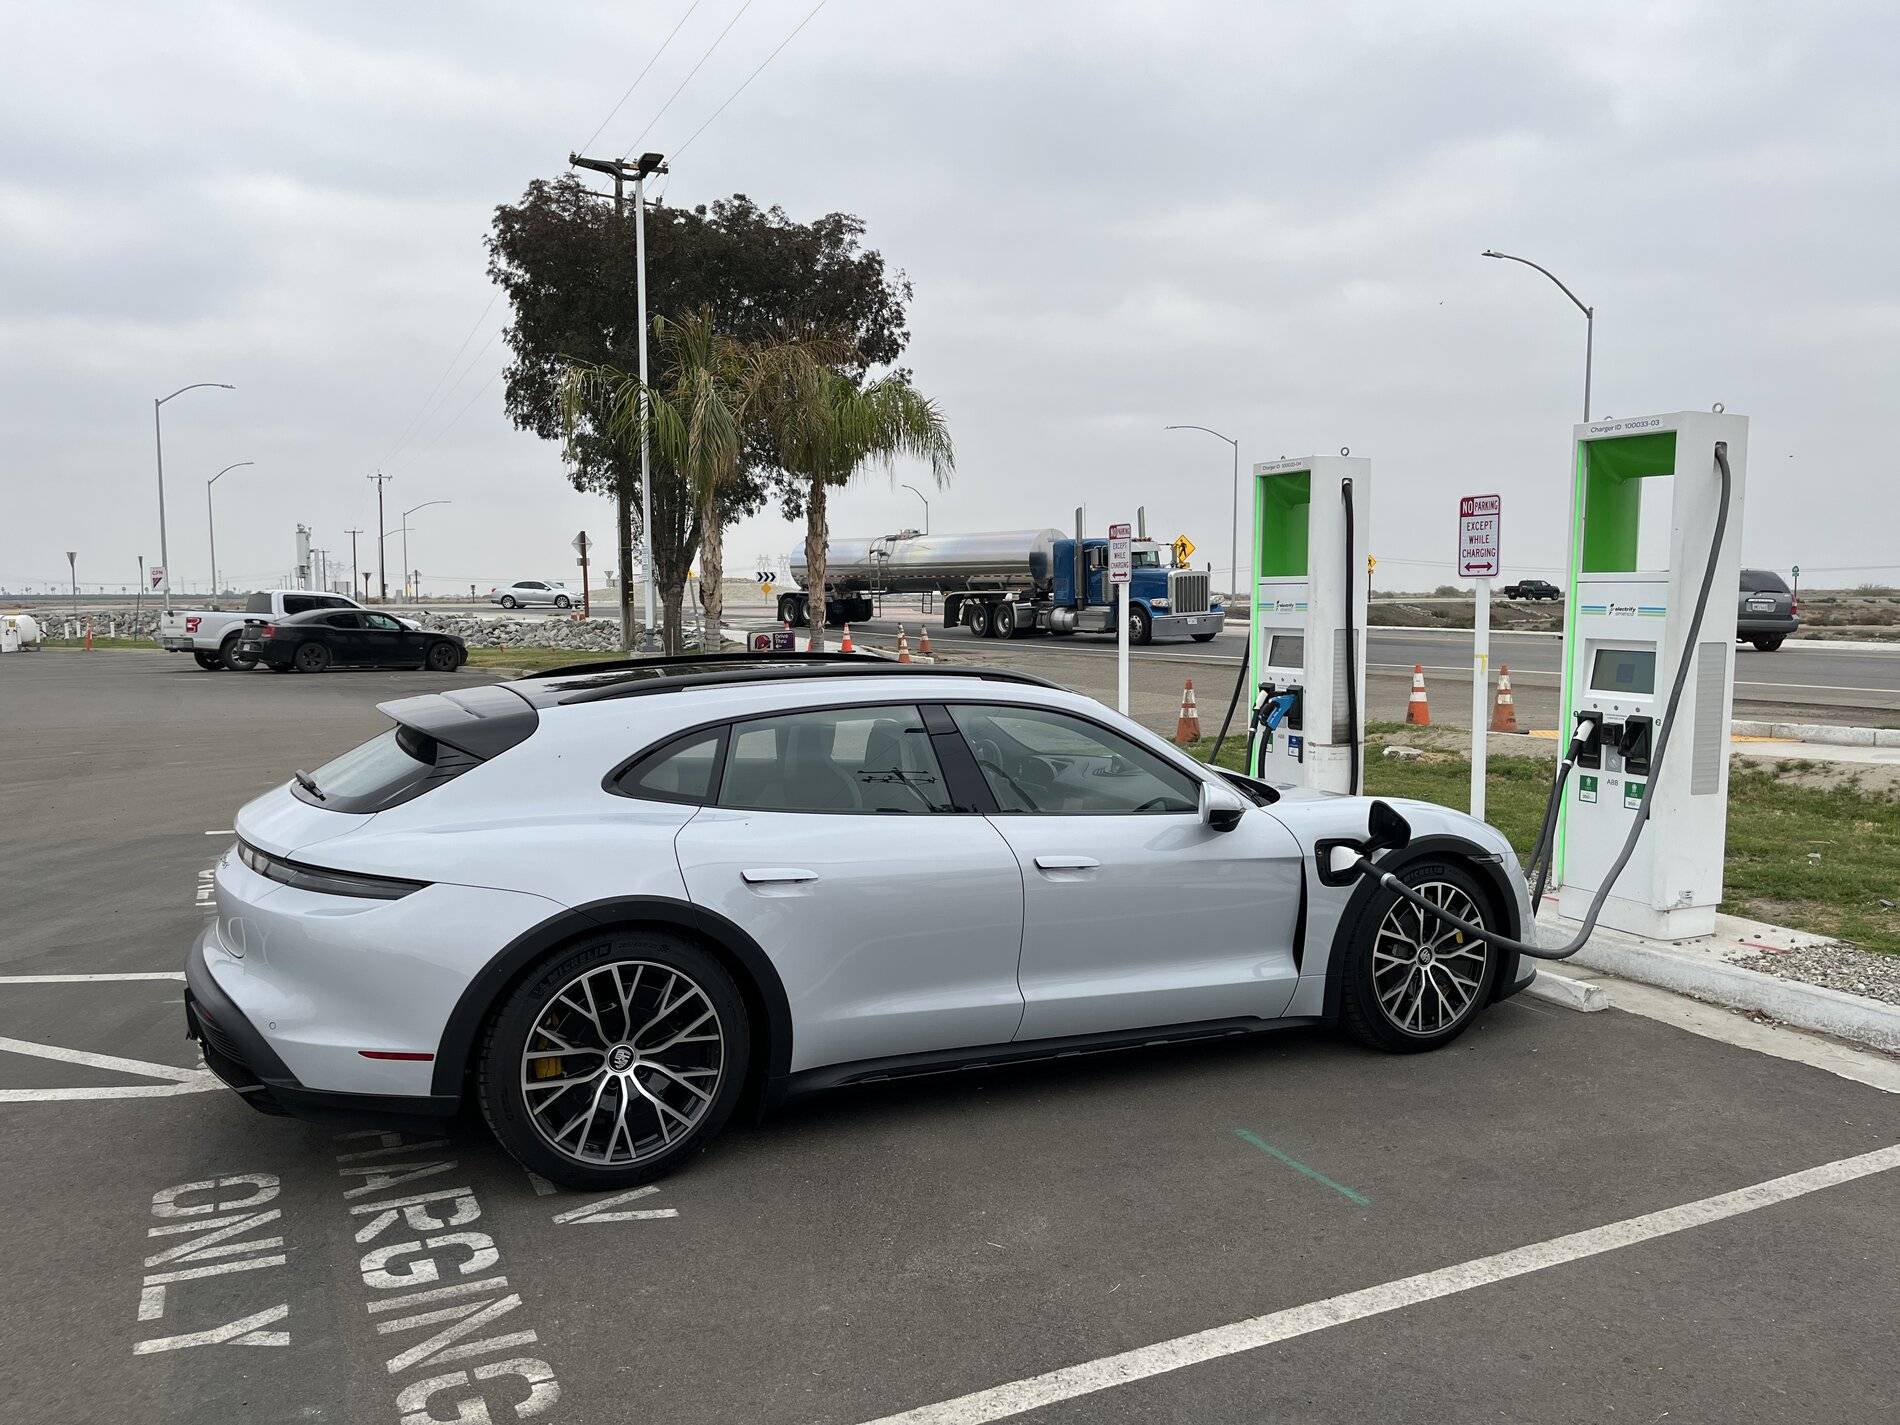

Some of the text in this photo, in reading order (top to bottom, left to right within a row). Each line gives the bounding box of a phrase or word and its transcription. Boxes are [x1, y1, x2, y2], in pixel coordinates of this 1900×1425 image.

[1591, 425, 1613, 433] Charger
[1462, 499, 1498, 514] NO PARKING
[1466, 520, 1493, 531] EXCEPT
[1469, 534, 1490, 544] WHILE
[1112, 542, 1128, 550] EXCEPT
[1462, 547, 1496, 558] CHARGING
[1606, 778, 1619, 786] ABB
[133, 1172, 290, 1356] ONLY
[333, 1128, 562, 1425] HARGING
